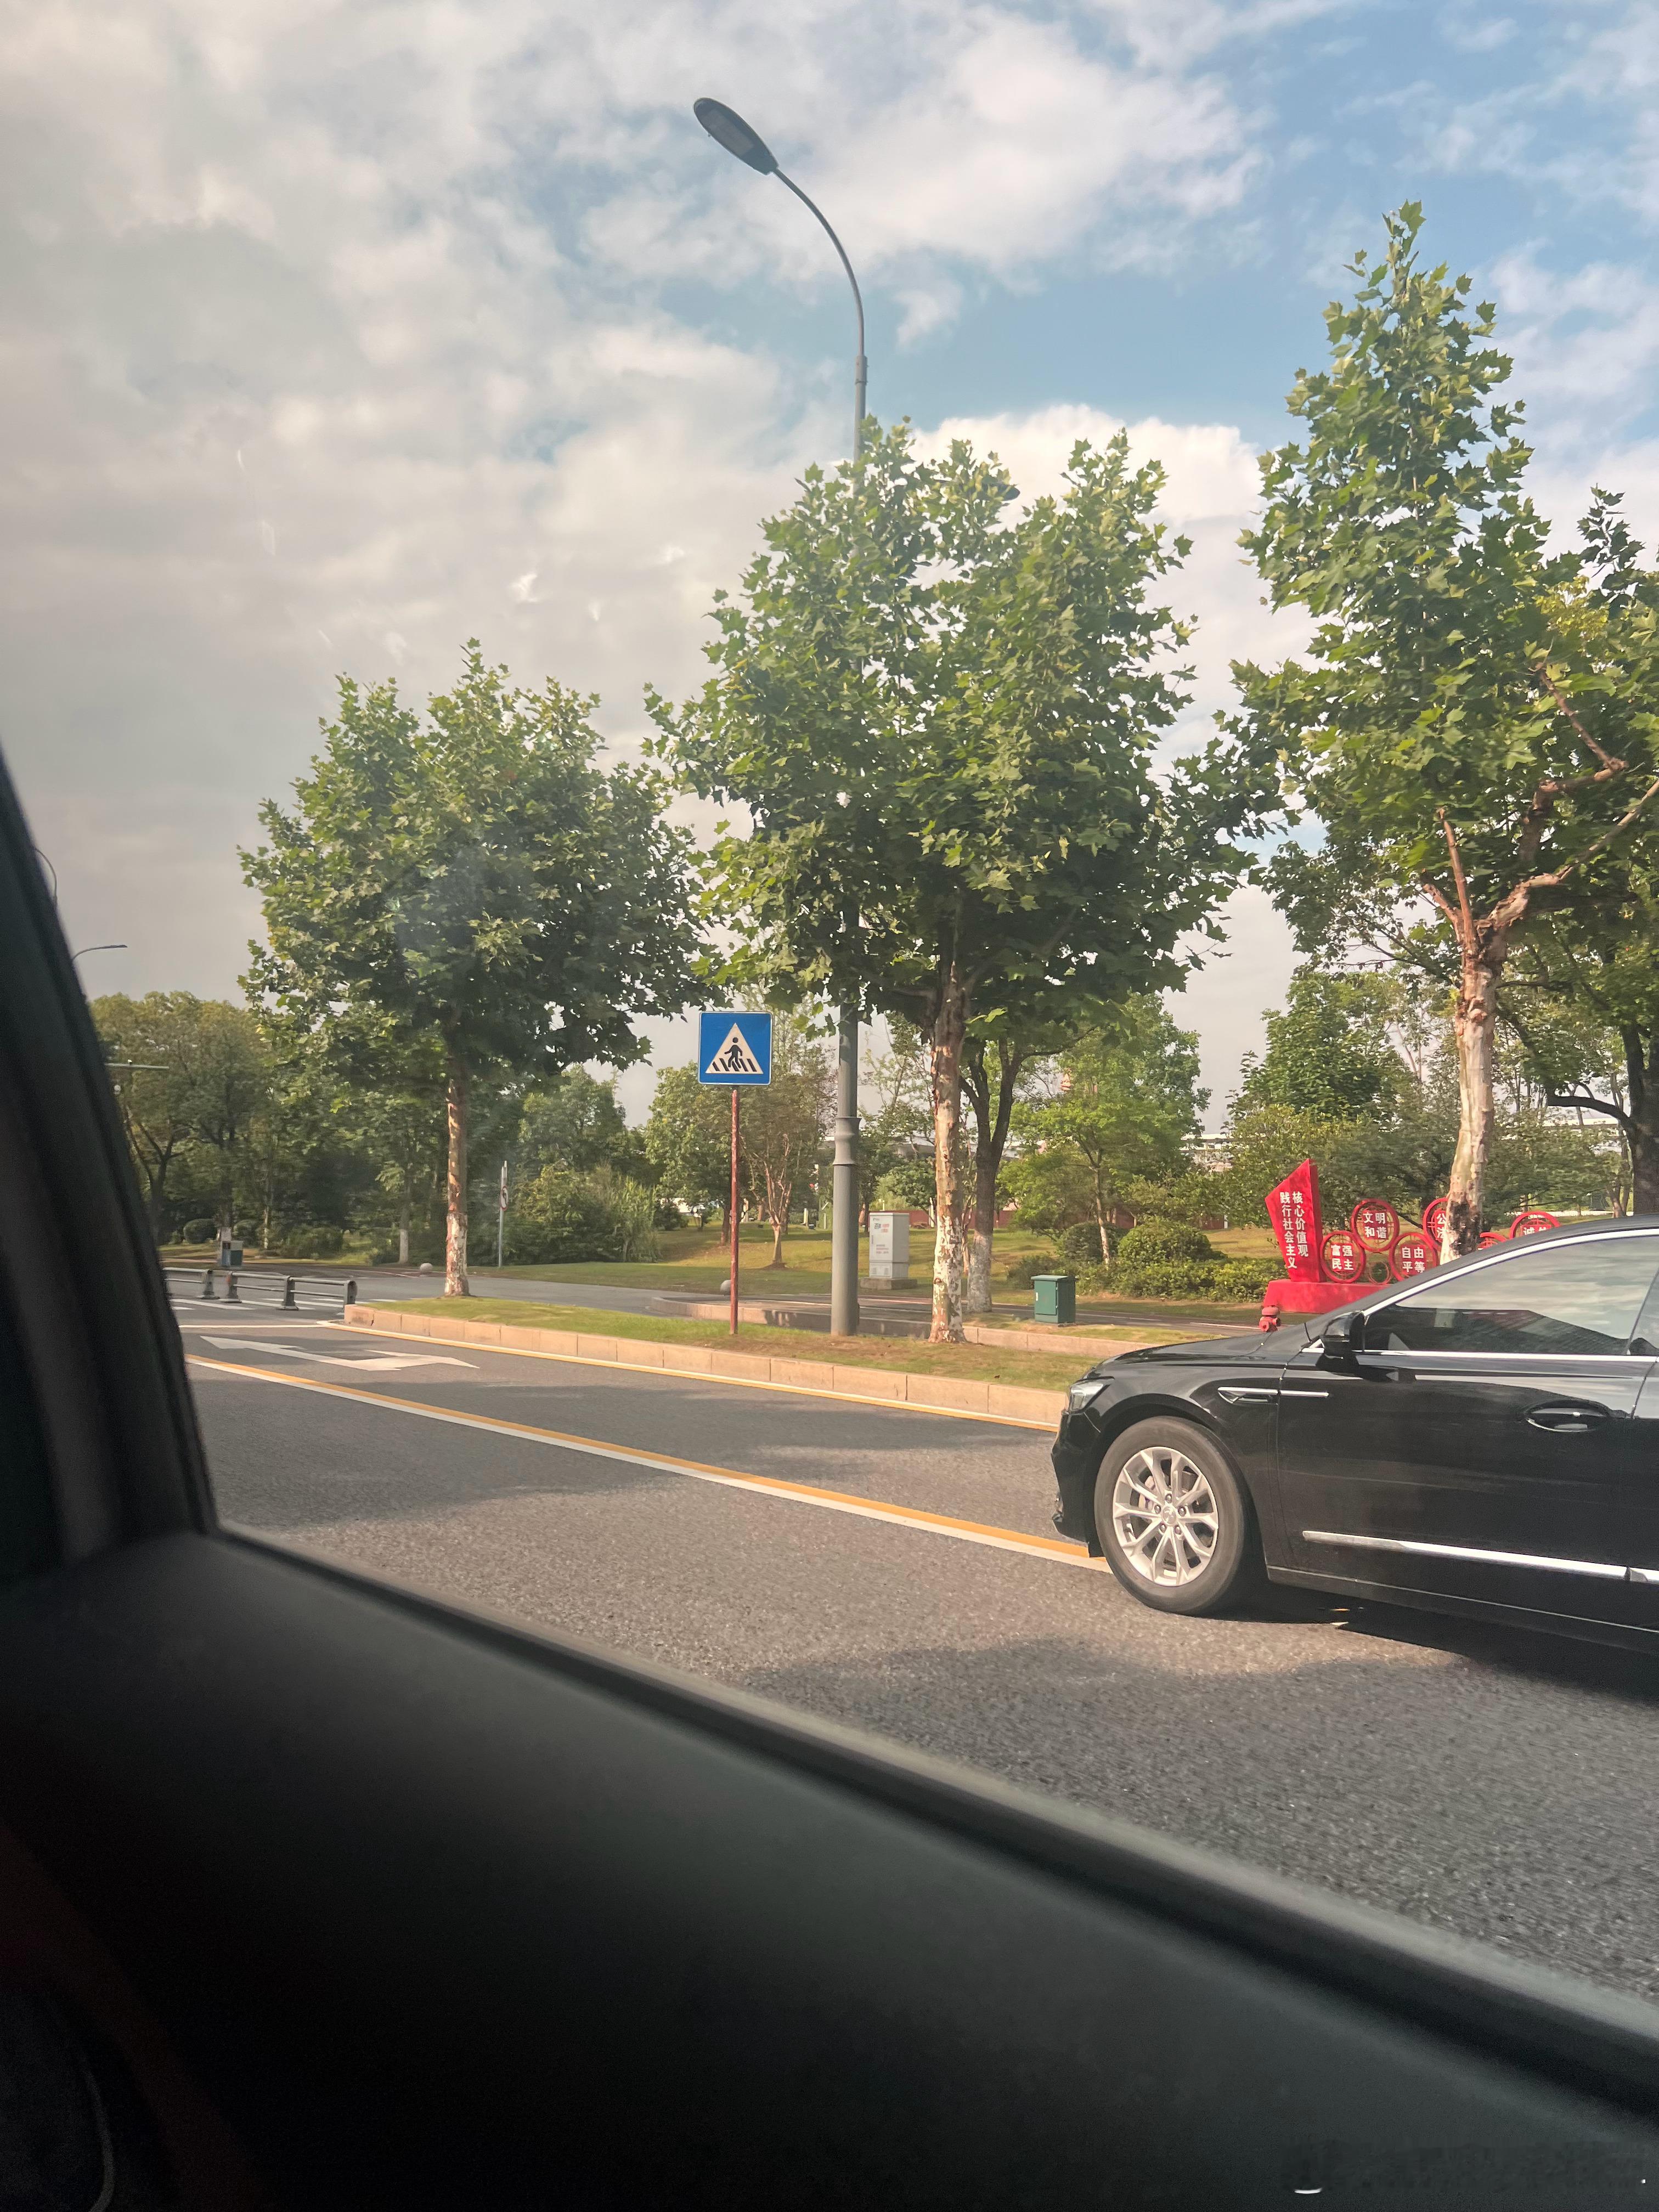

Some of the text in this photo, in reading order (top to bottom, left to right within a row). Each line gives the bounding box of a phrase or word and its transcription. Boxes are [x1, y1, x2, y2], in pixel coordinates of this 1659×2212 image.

[1292, 1191, 1309, 1257] 核心价值观
[1363, 1212, 1386, 1224] 文明
[1279, 1191, 1297, 1269] 践行社会主义
[1364, 1226, 1387, 1239] 和谐
[1330, 1244, 1353, 1257] 富强
[1402, 1246, 1424, 1259] 自由
[1332, 1257, 1354, 1270] 民主
[1402, 1261, 1425, 1273] 平等
